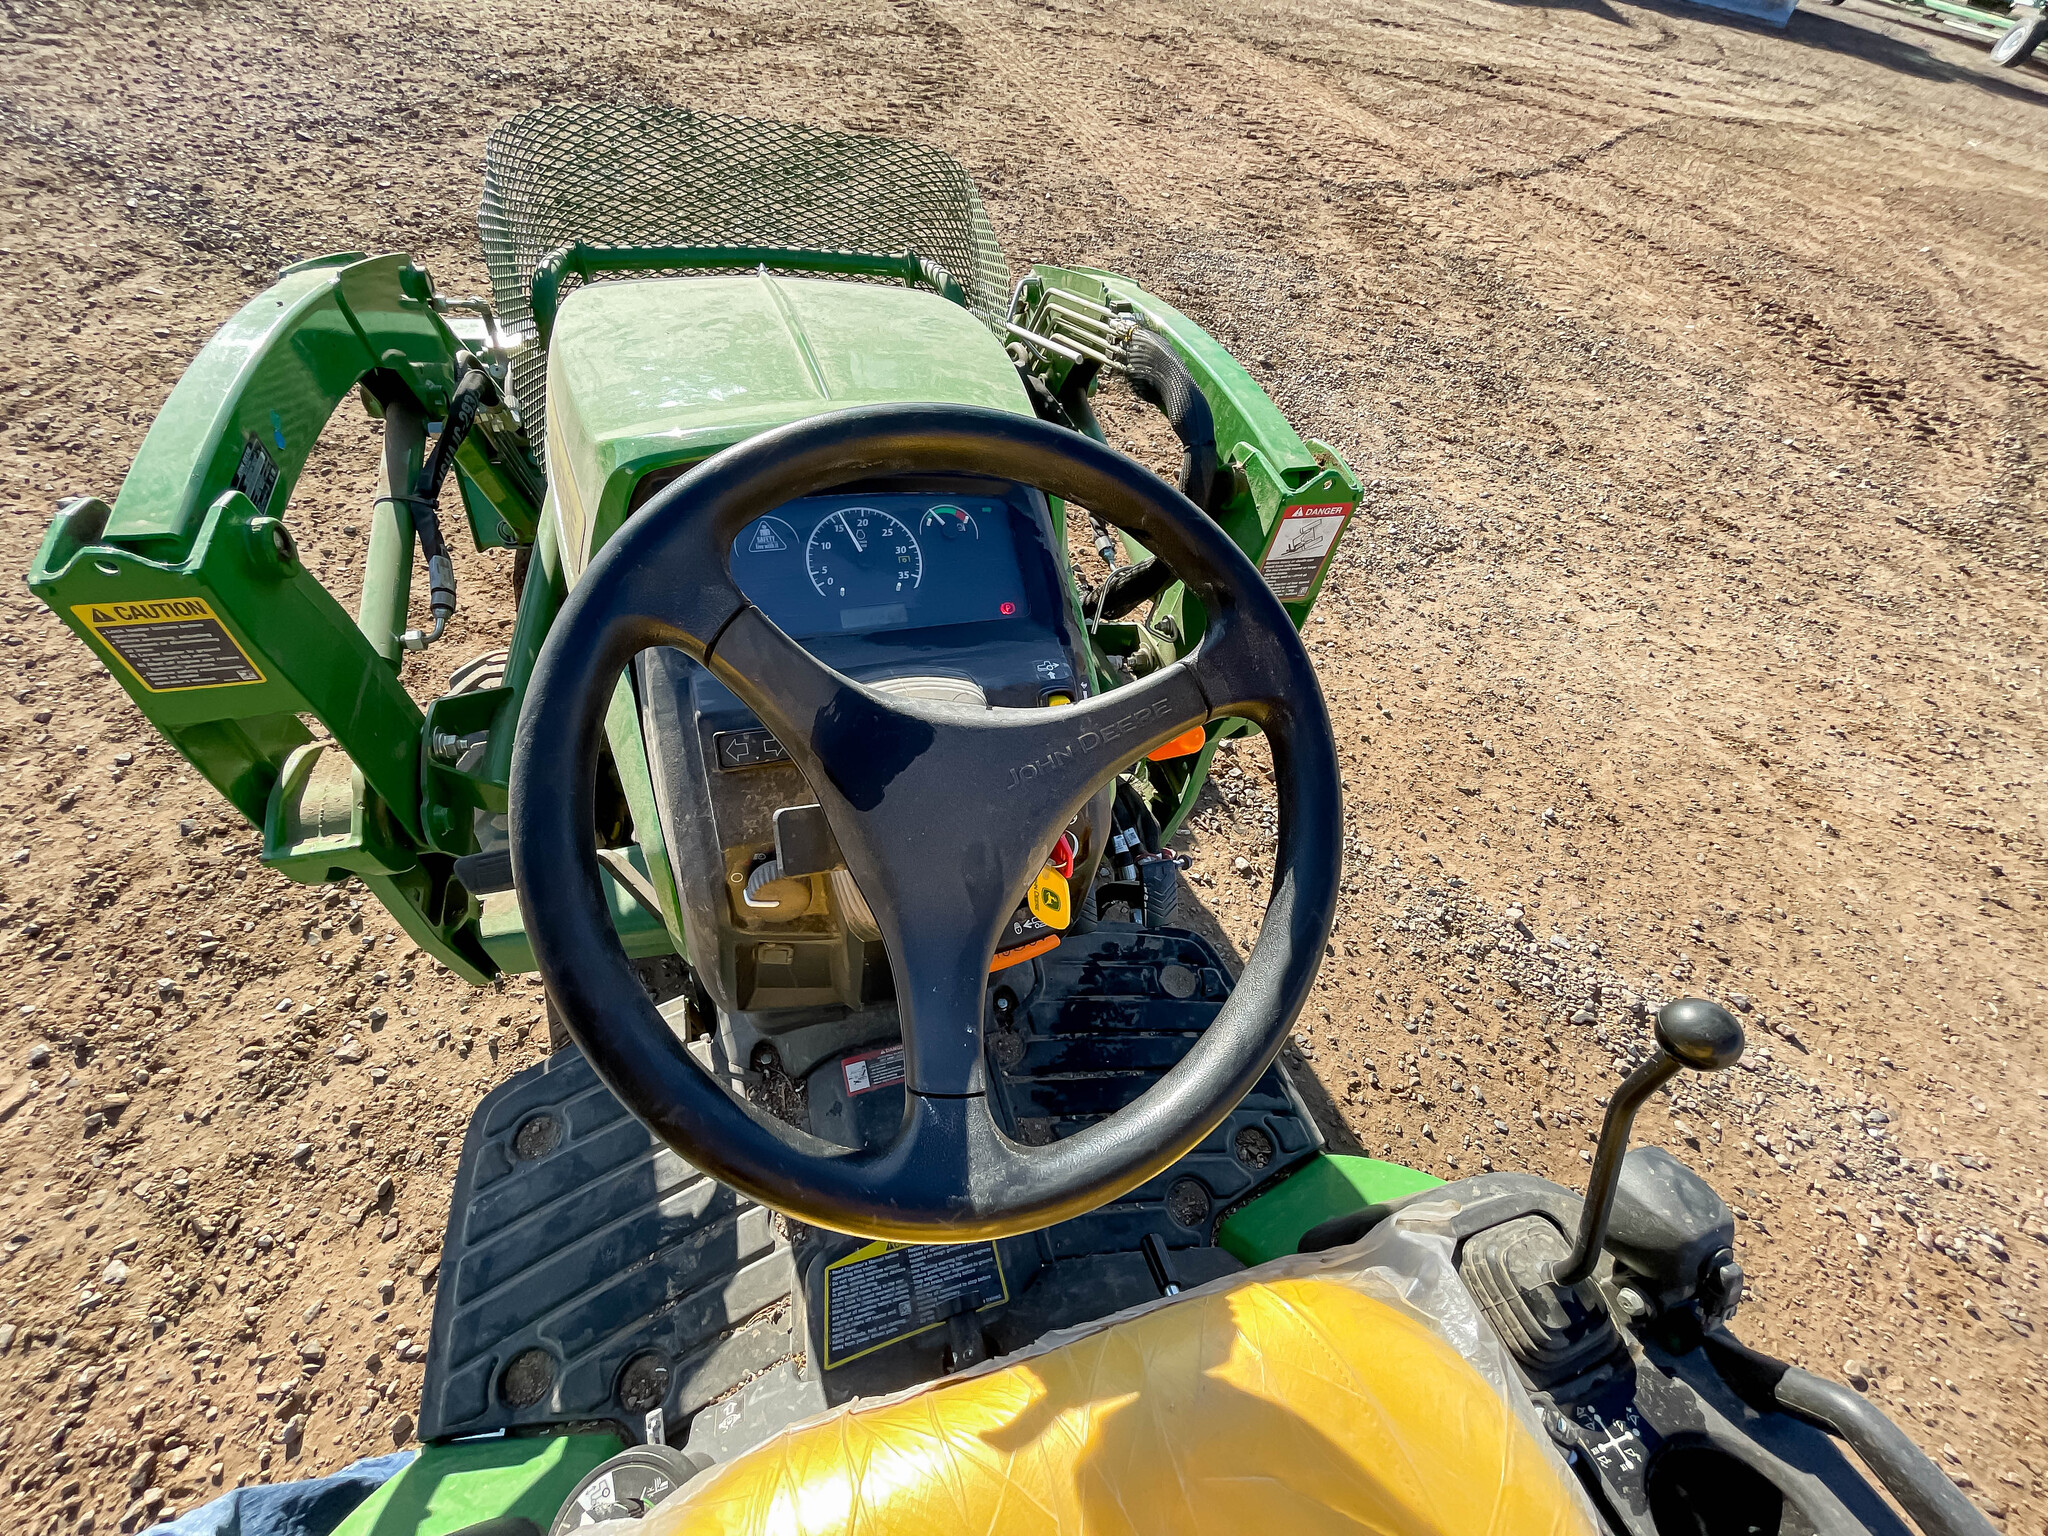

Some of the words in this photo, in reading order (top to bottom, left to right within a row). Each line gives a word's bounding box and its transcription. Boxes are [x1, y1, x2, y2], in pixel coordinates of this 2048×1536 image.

[1305, 507, 1343, 516] DANGER
[857, 519, 869, 527] 20
[834, 524, 844, 533] 15
[881, 528, 893, 537] 25
[821, 542, 831, 550] 10
[895, 546, 907, 554] 30
[821, 566, 828, 574] 5
[898, 571, 910, 579] 35
[827, 577, 834, 585] 0
[113, 600, 208, 621] CAUTION
[1007, 745, 1074, 790] JOHN
[1077, 698, 1173, 755] DEERE
